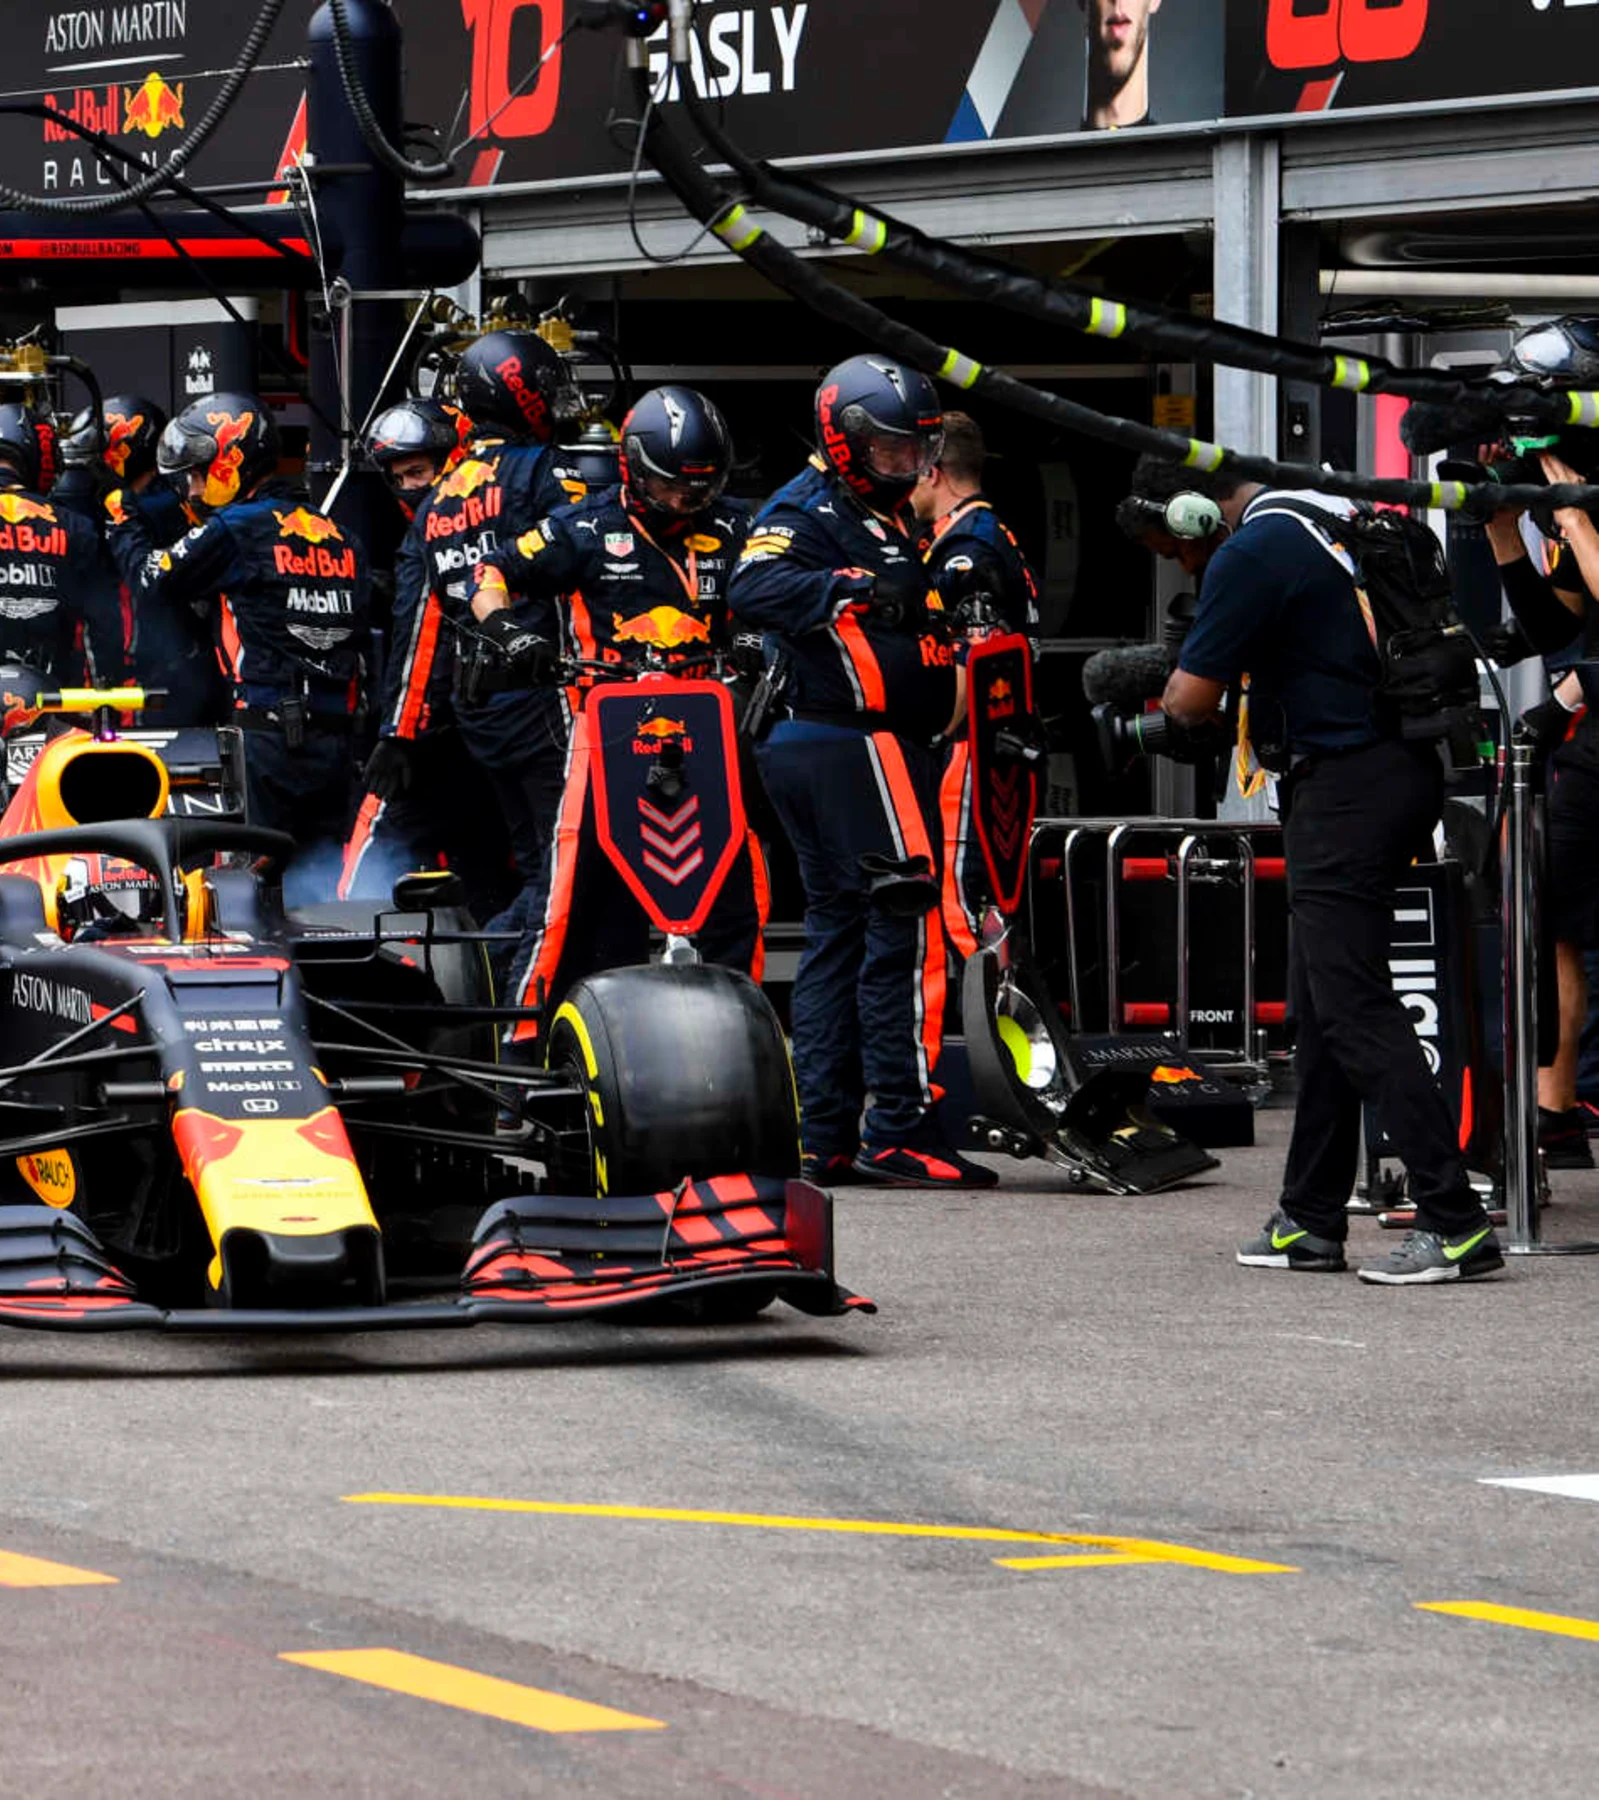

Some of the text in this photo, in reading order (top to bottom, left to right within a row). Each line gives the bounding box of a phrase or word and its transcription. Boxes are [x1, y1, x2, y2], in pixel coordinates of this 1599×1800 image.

[45, 0, 186, 53] ASTON MARTIN
[462, 0, 563, 139] 10
[15, 524, 68, 556] Bull
[273, 545, 355, 579] Red Bull
[286, 587, 339, 614] Mobil
[90, 881, 121, 893] ASTON
[12, 973, 92, 1024] ASTON MARTIN
[1190, 1010, 1234, 1023] FRONT
[206, 1081, 275, 1092] Mobil
[35, 1161, 72, 1190] RAUCH
